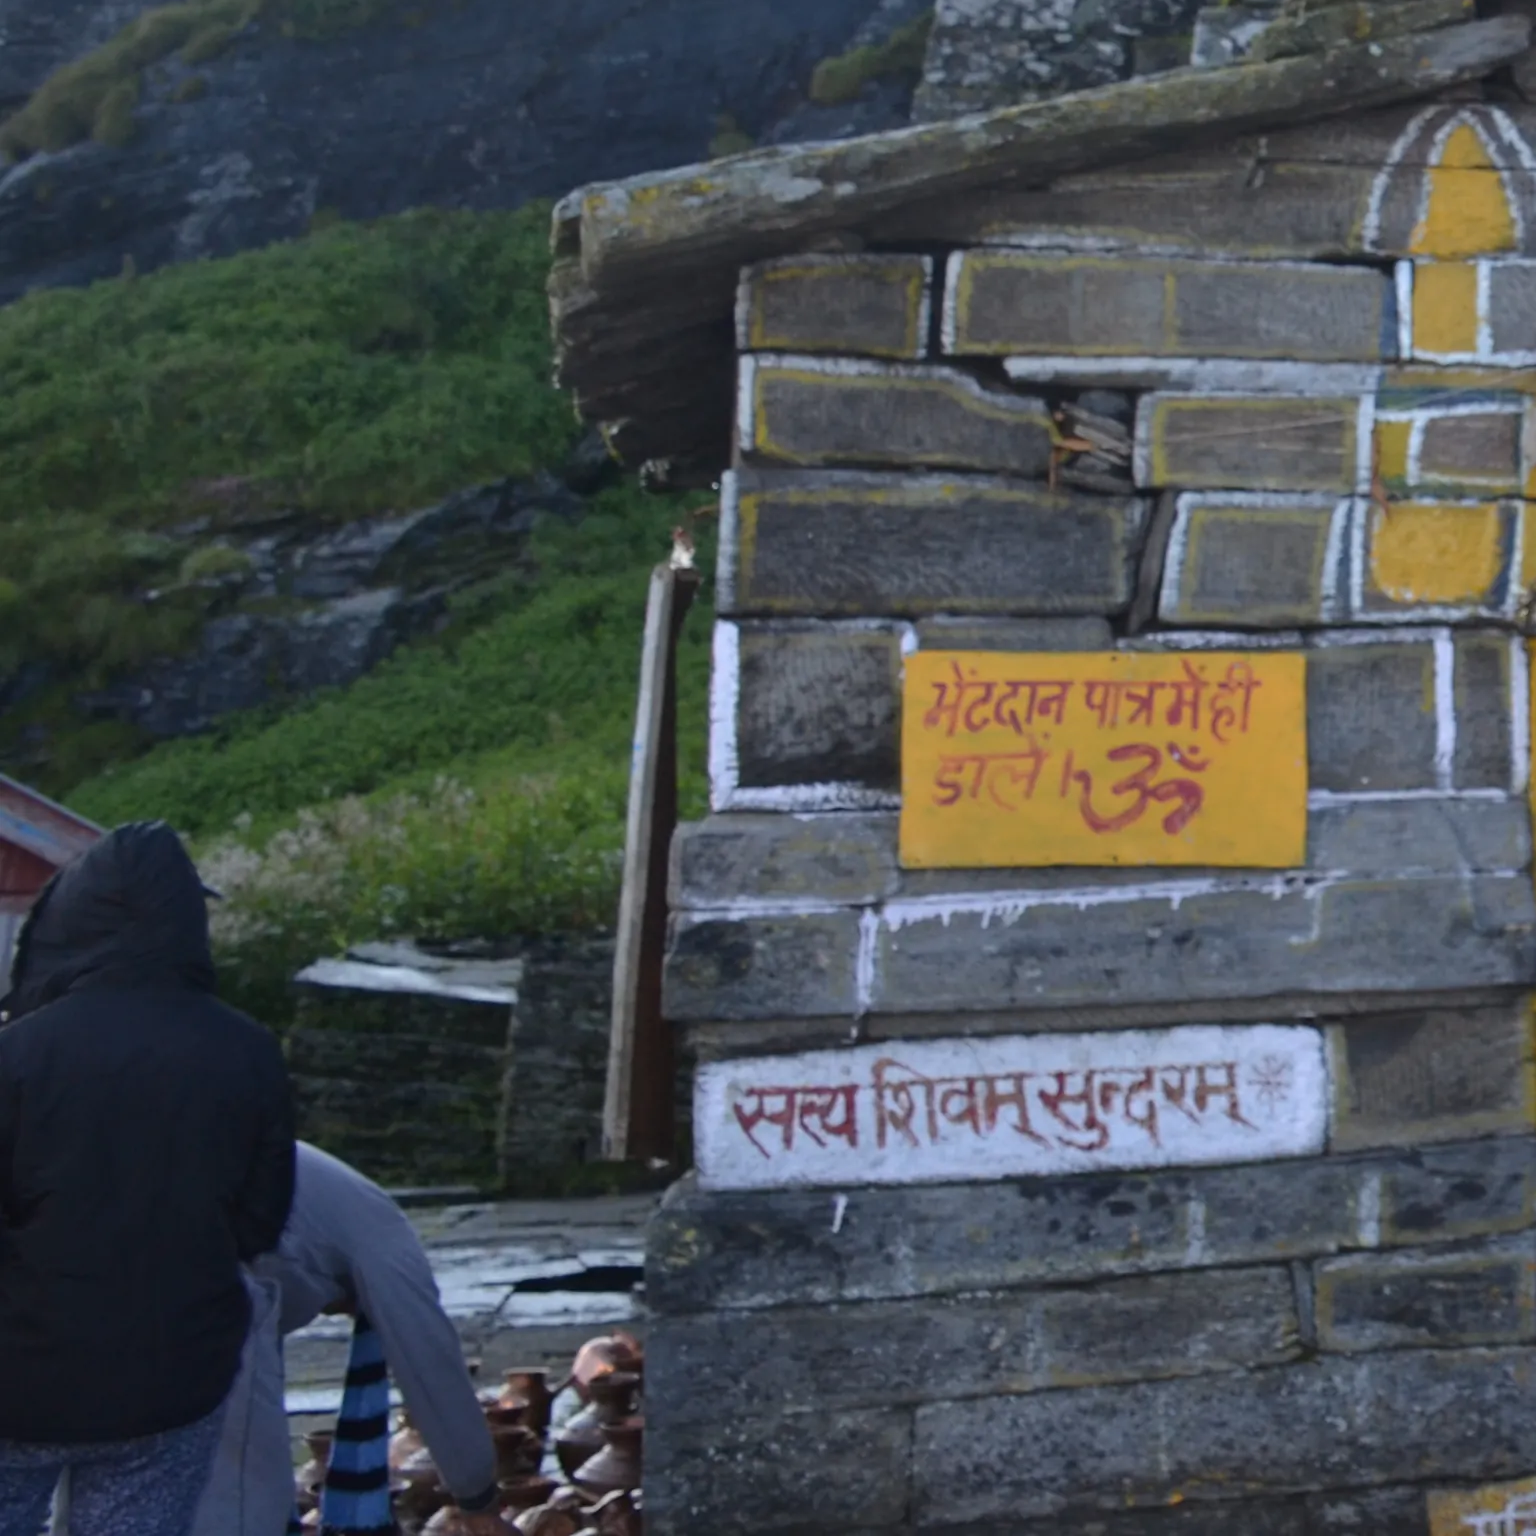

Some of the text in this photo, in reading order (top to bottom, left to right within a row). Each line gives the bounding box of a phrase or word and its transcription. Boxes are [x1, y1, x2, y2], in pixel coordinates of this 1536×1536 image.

[994, 681, 1074, 734] दान
[1084, 681, 1166, 729] पात्र
[1166, 659, 1209, 731] में
[1209, 662, 1262, 743] ही
[733, 1057, 1260, 1160] सत्य शिवम् सुन्दरम्
